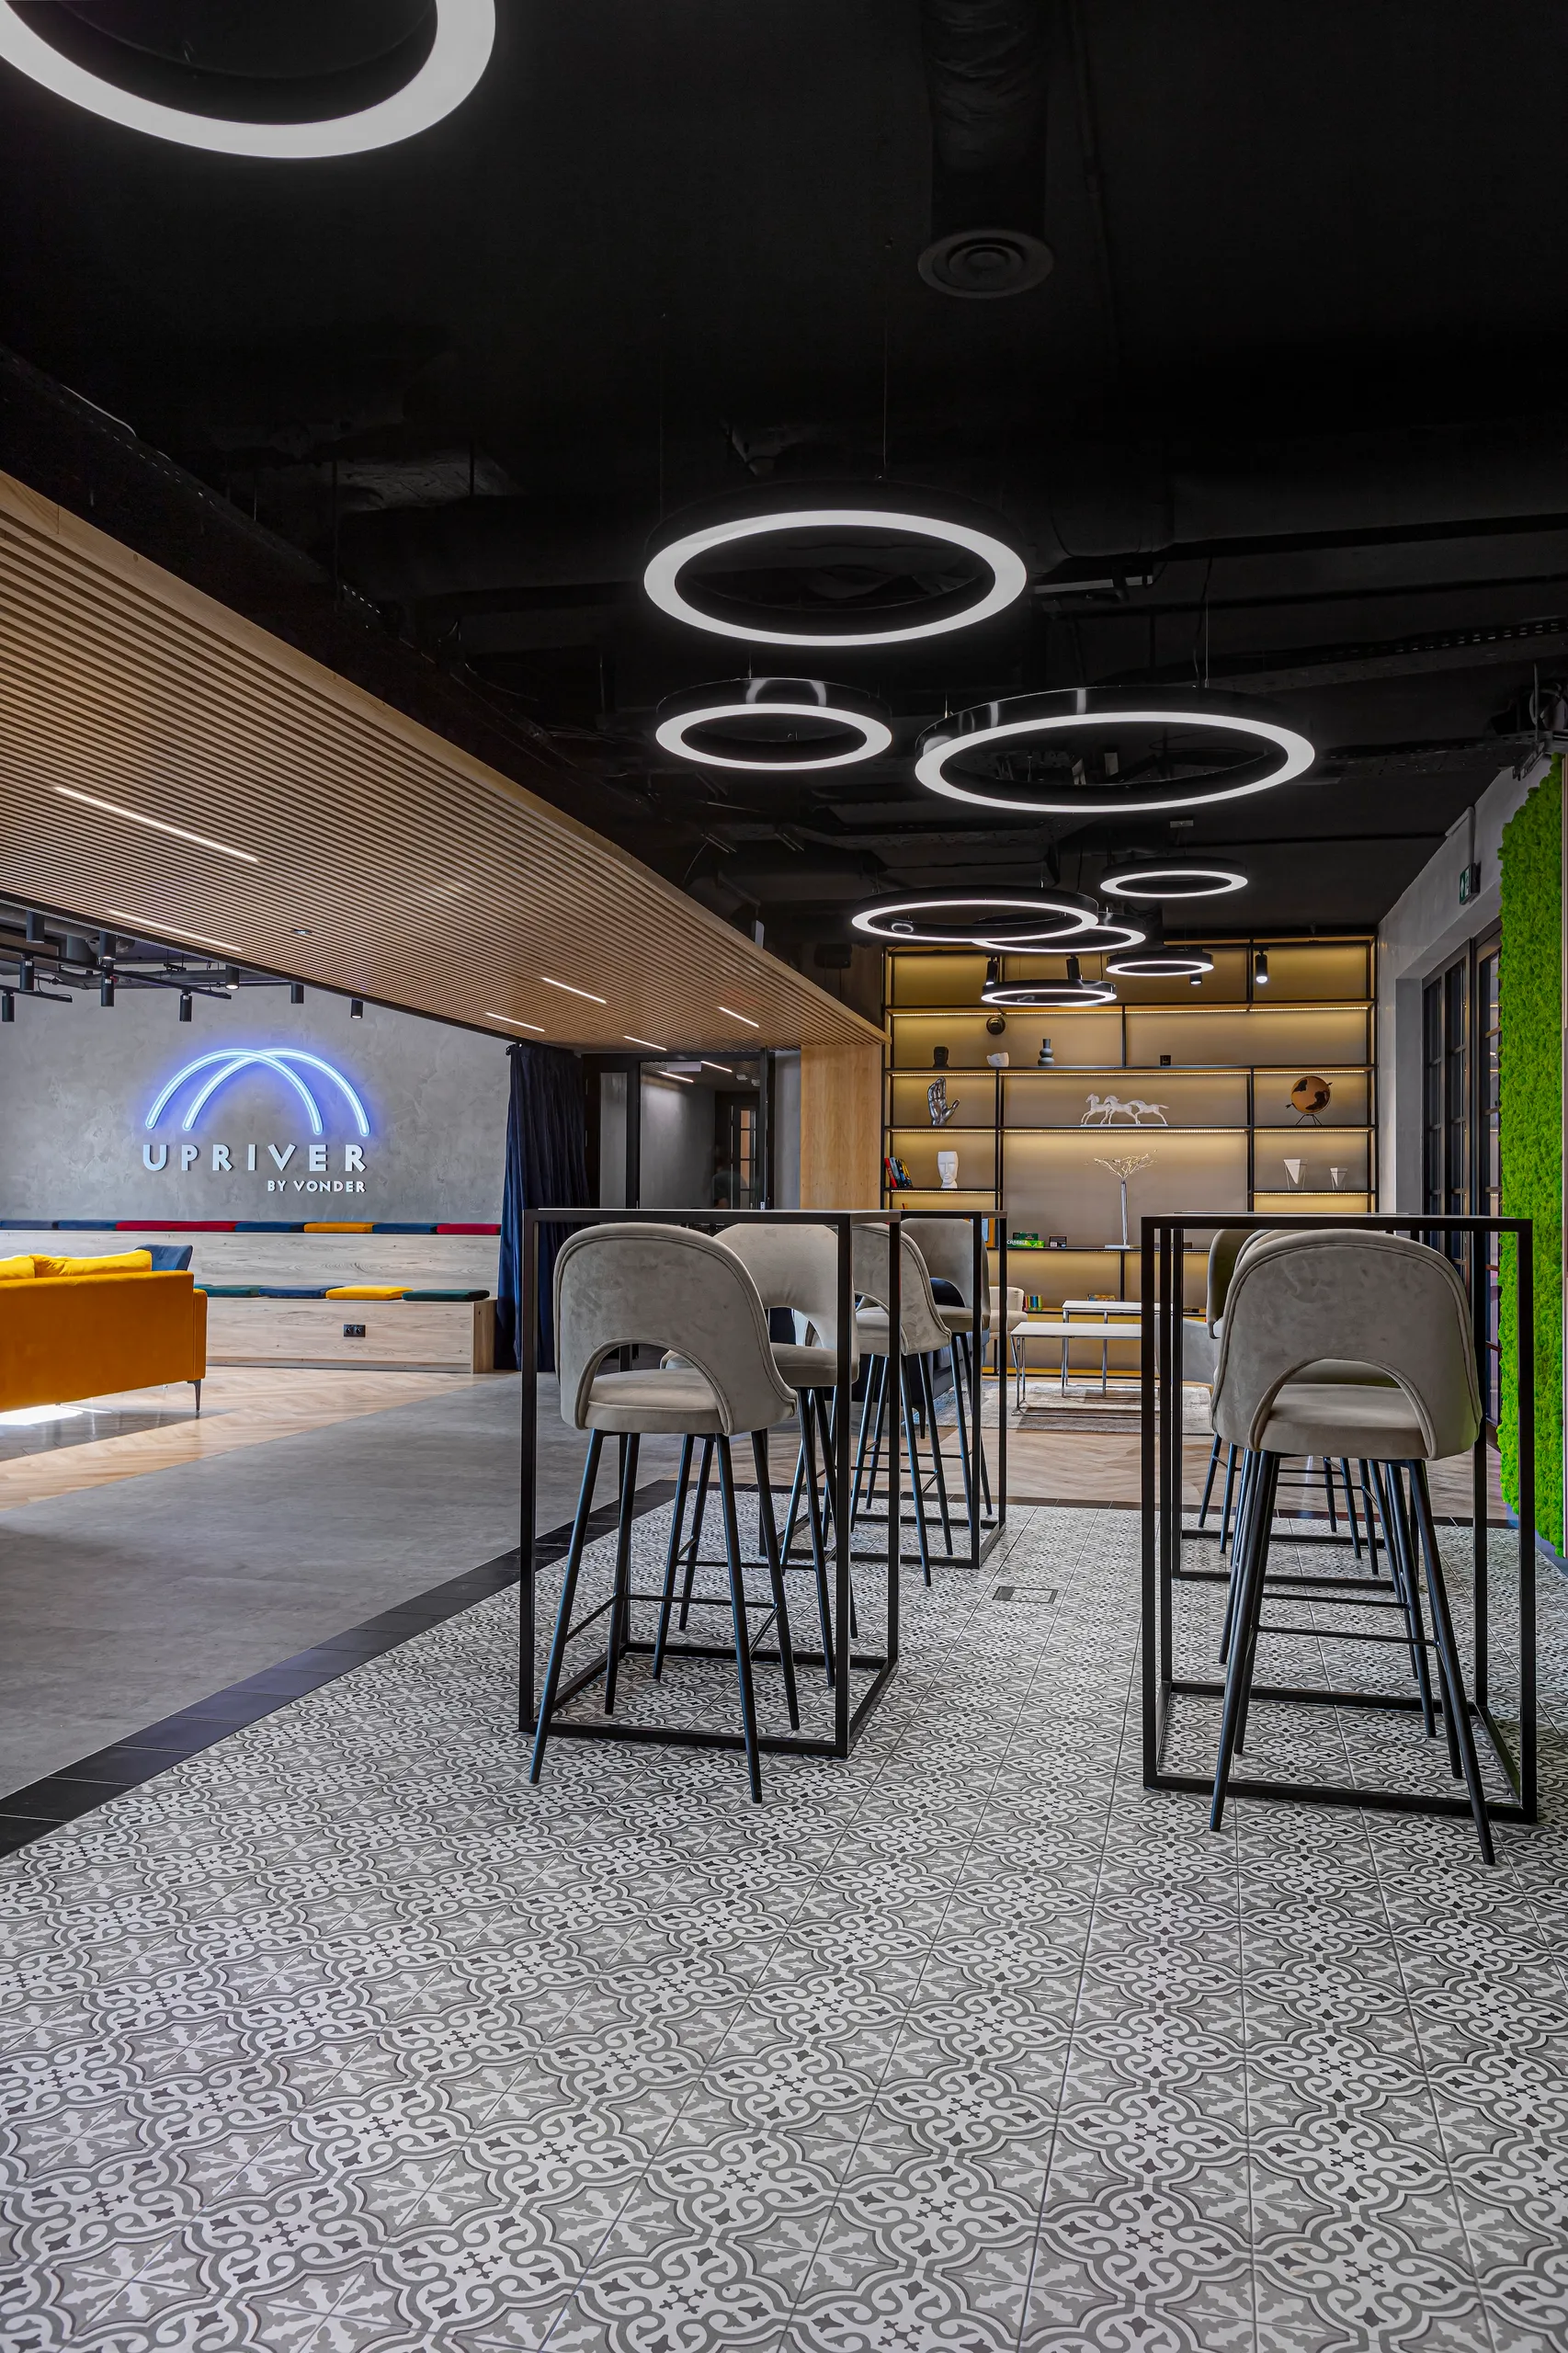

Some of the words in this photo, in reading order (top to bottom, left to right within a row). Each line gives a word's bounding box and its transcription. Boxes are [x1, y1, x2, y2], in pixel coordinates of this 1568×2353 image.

[142, 1143, 368, 1172] UPRIVER
[267, 1180, 288, 1192] BY
[293, 1180, 367, 1193] VONDER
